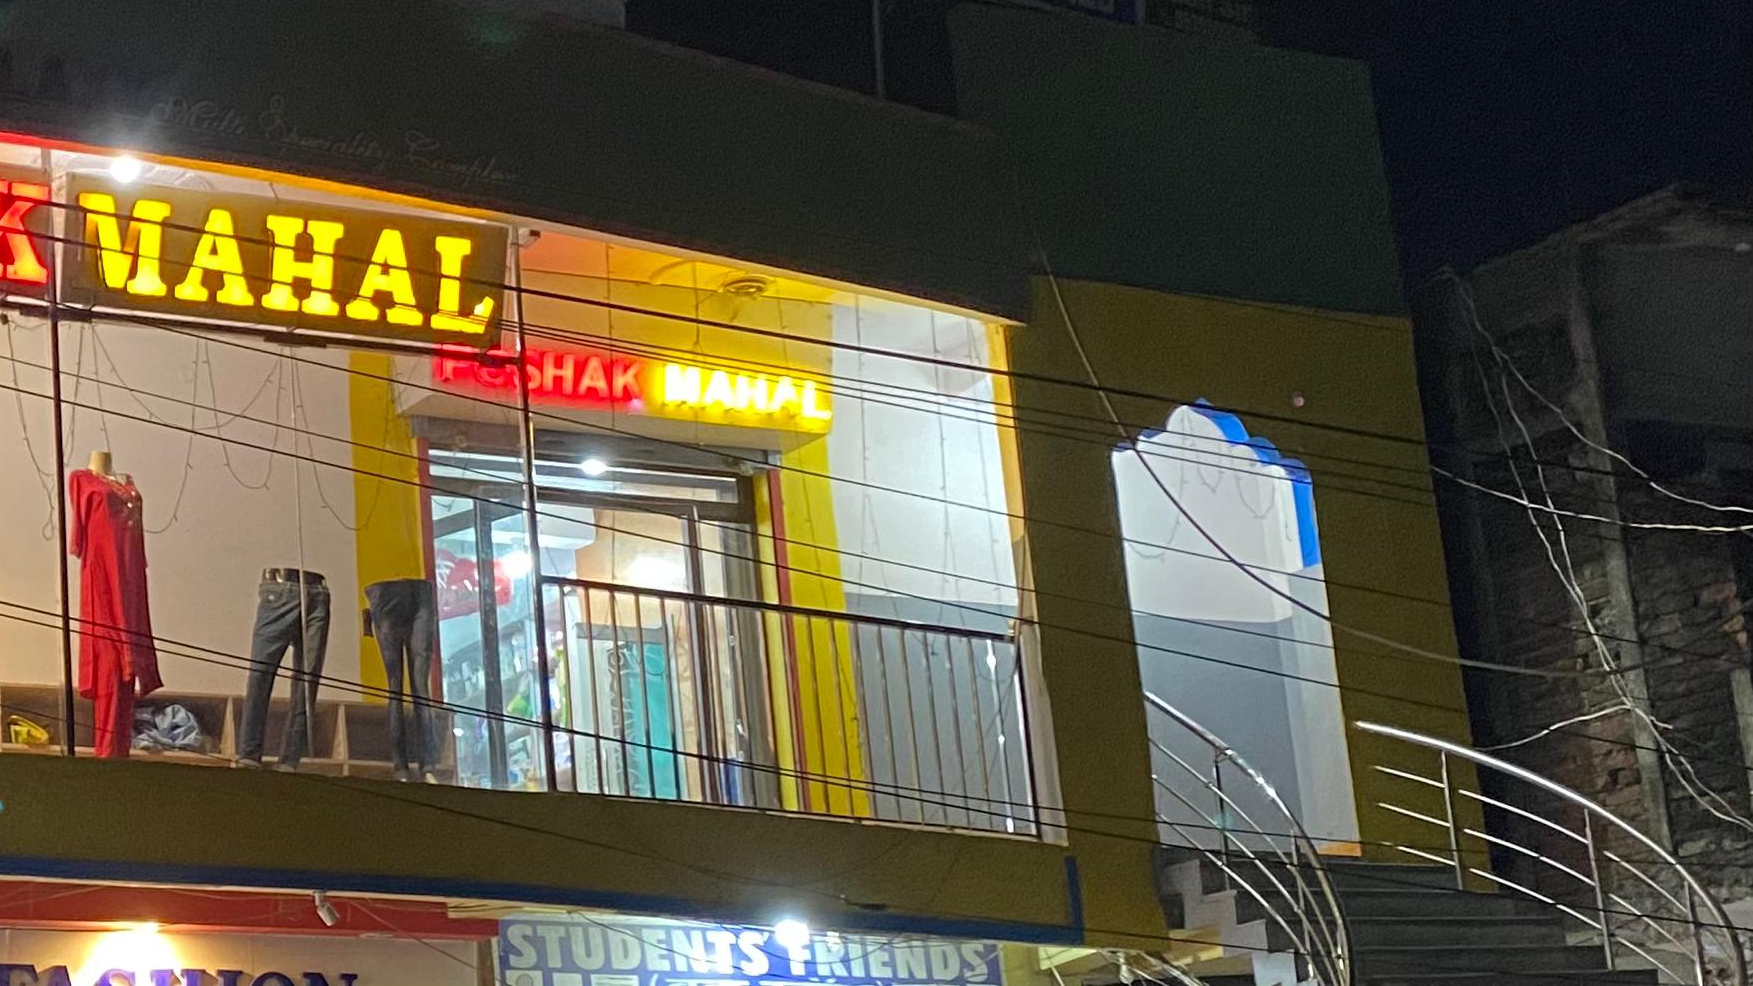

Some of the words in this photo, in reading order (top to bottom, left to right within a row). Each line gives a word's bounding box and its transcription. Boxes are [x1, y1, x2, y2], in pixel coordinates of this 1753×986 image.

[78, 191, 494, 335] MAHAL
[661, 361, 834, 420] MAHAL
[787, 934, 990, 983] FRIENDS
